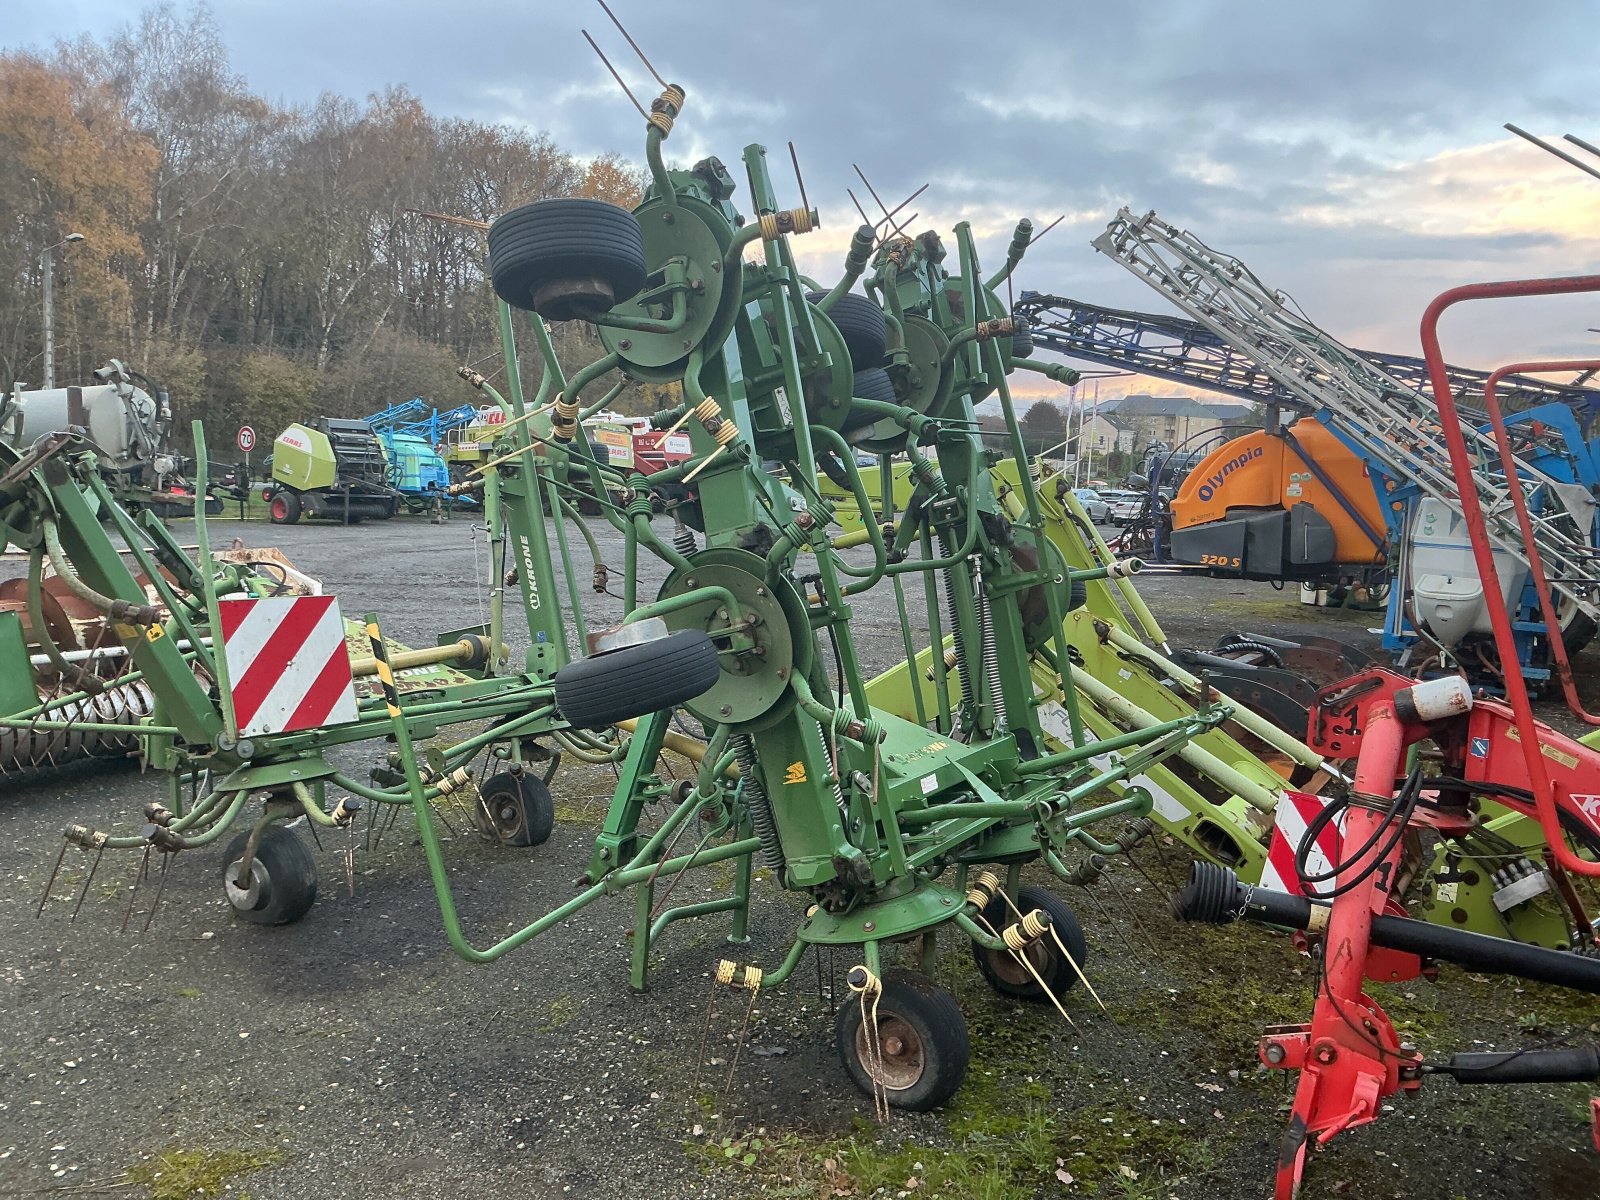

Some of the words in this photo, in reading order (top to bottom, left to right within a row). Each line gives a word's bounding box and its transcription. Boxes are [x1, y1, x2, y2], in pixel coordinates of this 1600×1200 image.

[242, 434, 252, 444] 70
[282, 436, 304, 448] CLAAS
[1198, 446, 1263, 501] Olympia
[520, 535, 538, 592] KRONE
[1200, 554, 1228, 566] 320
[1231, 557, 1241, 567] S
